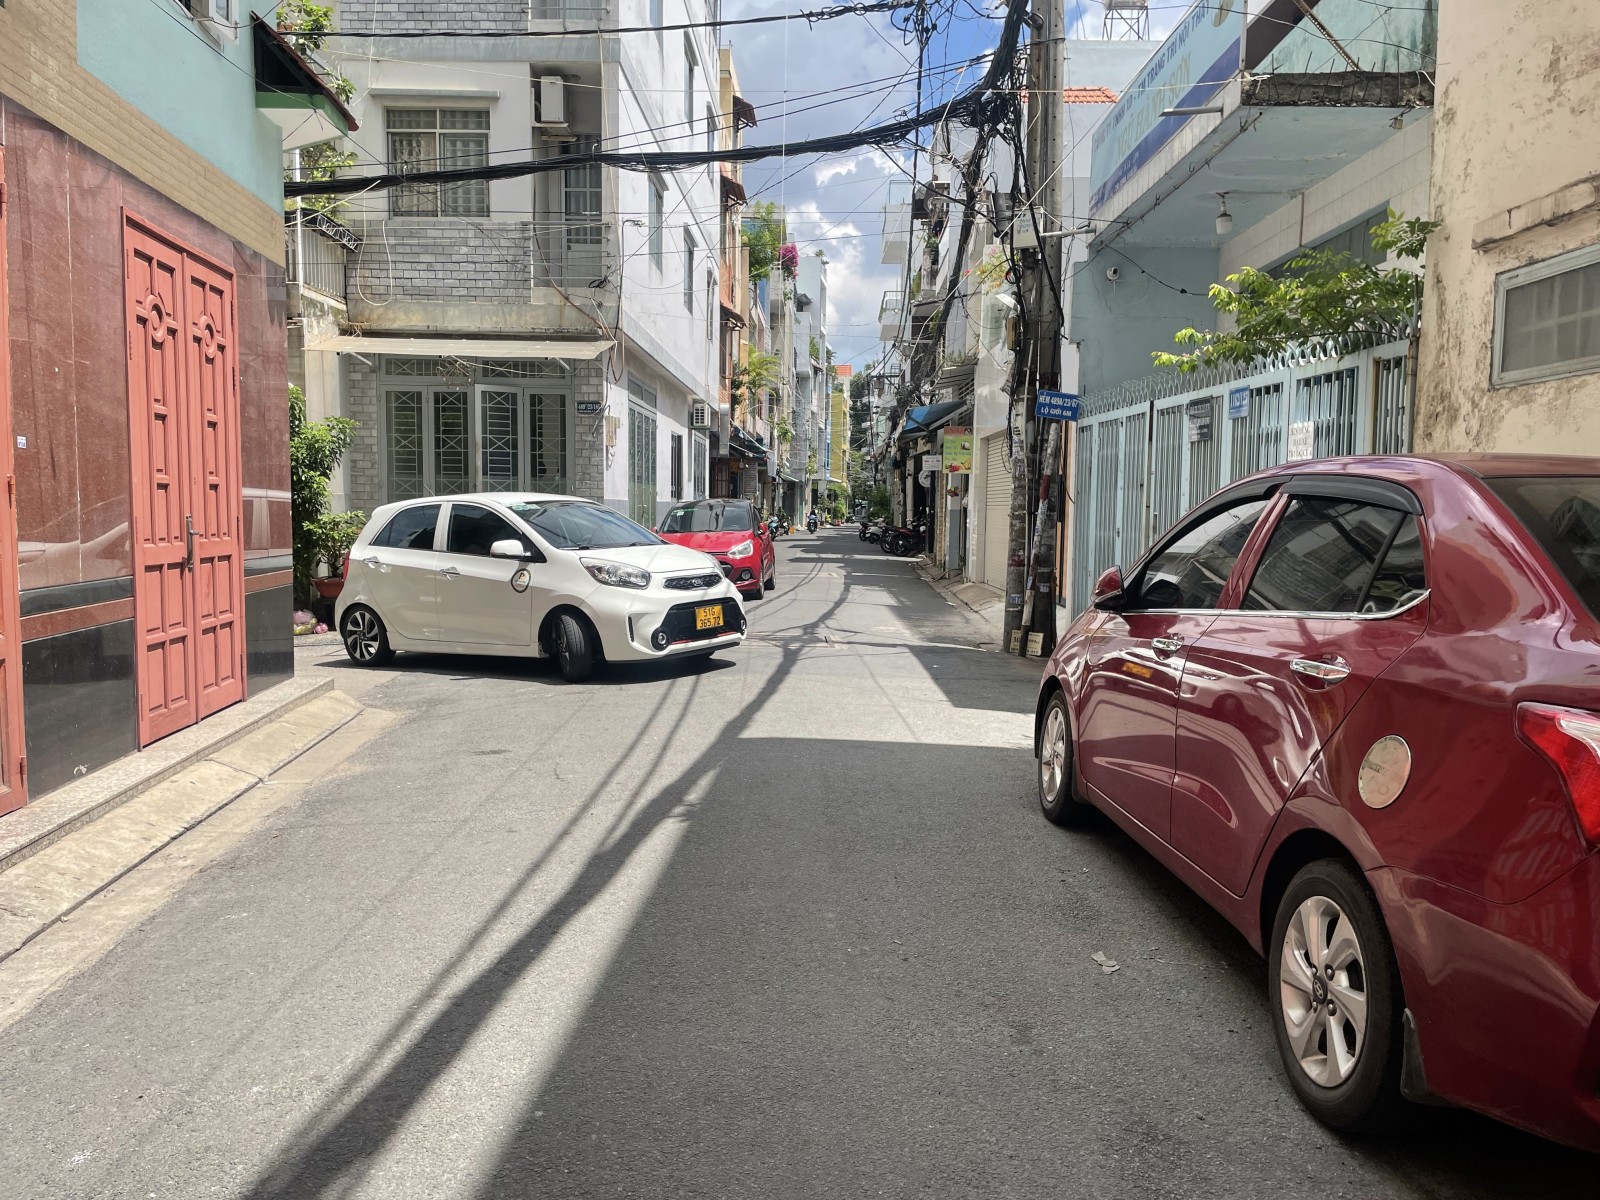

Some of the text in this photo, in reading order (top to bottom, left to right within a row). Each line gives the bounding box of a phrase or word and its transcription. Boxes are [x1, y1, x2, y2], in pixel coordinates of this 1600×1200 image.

[1147, 52, 1166, 88] TRANG
[1041, 406, 1049, 415] LỘ
[1050, 408, 1062, 416] GIỚI
[703, 607, 716, 618] 51G
[699, 616, 721, 628] 365.72
